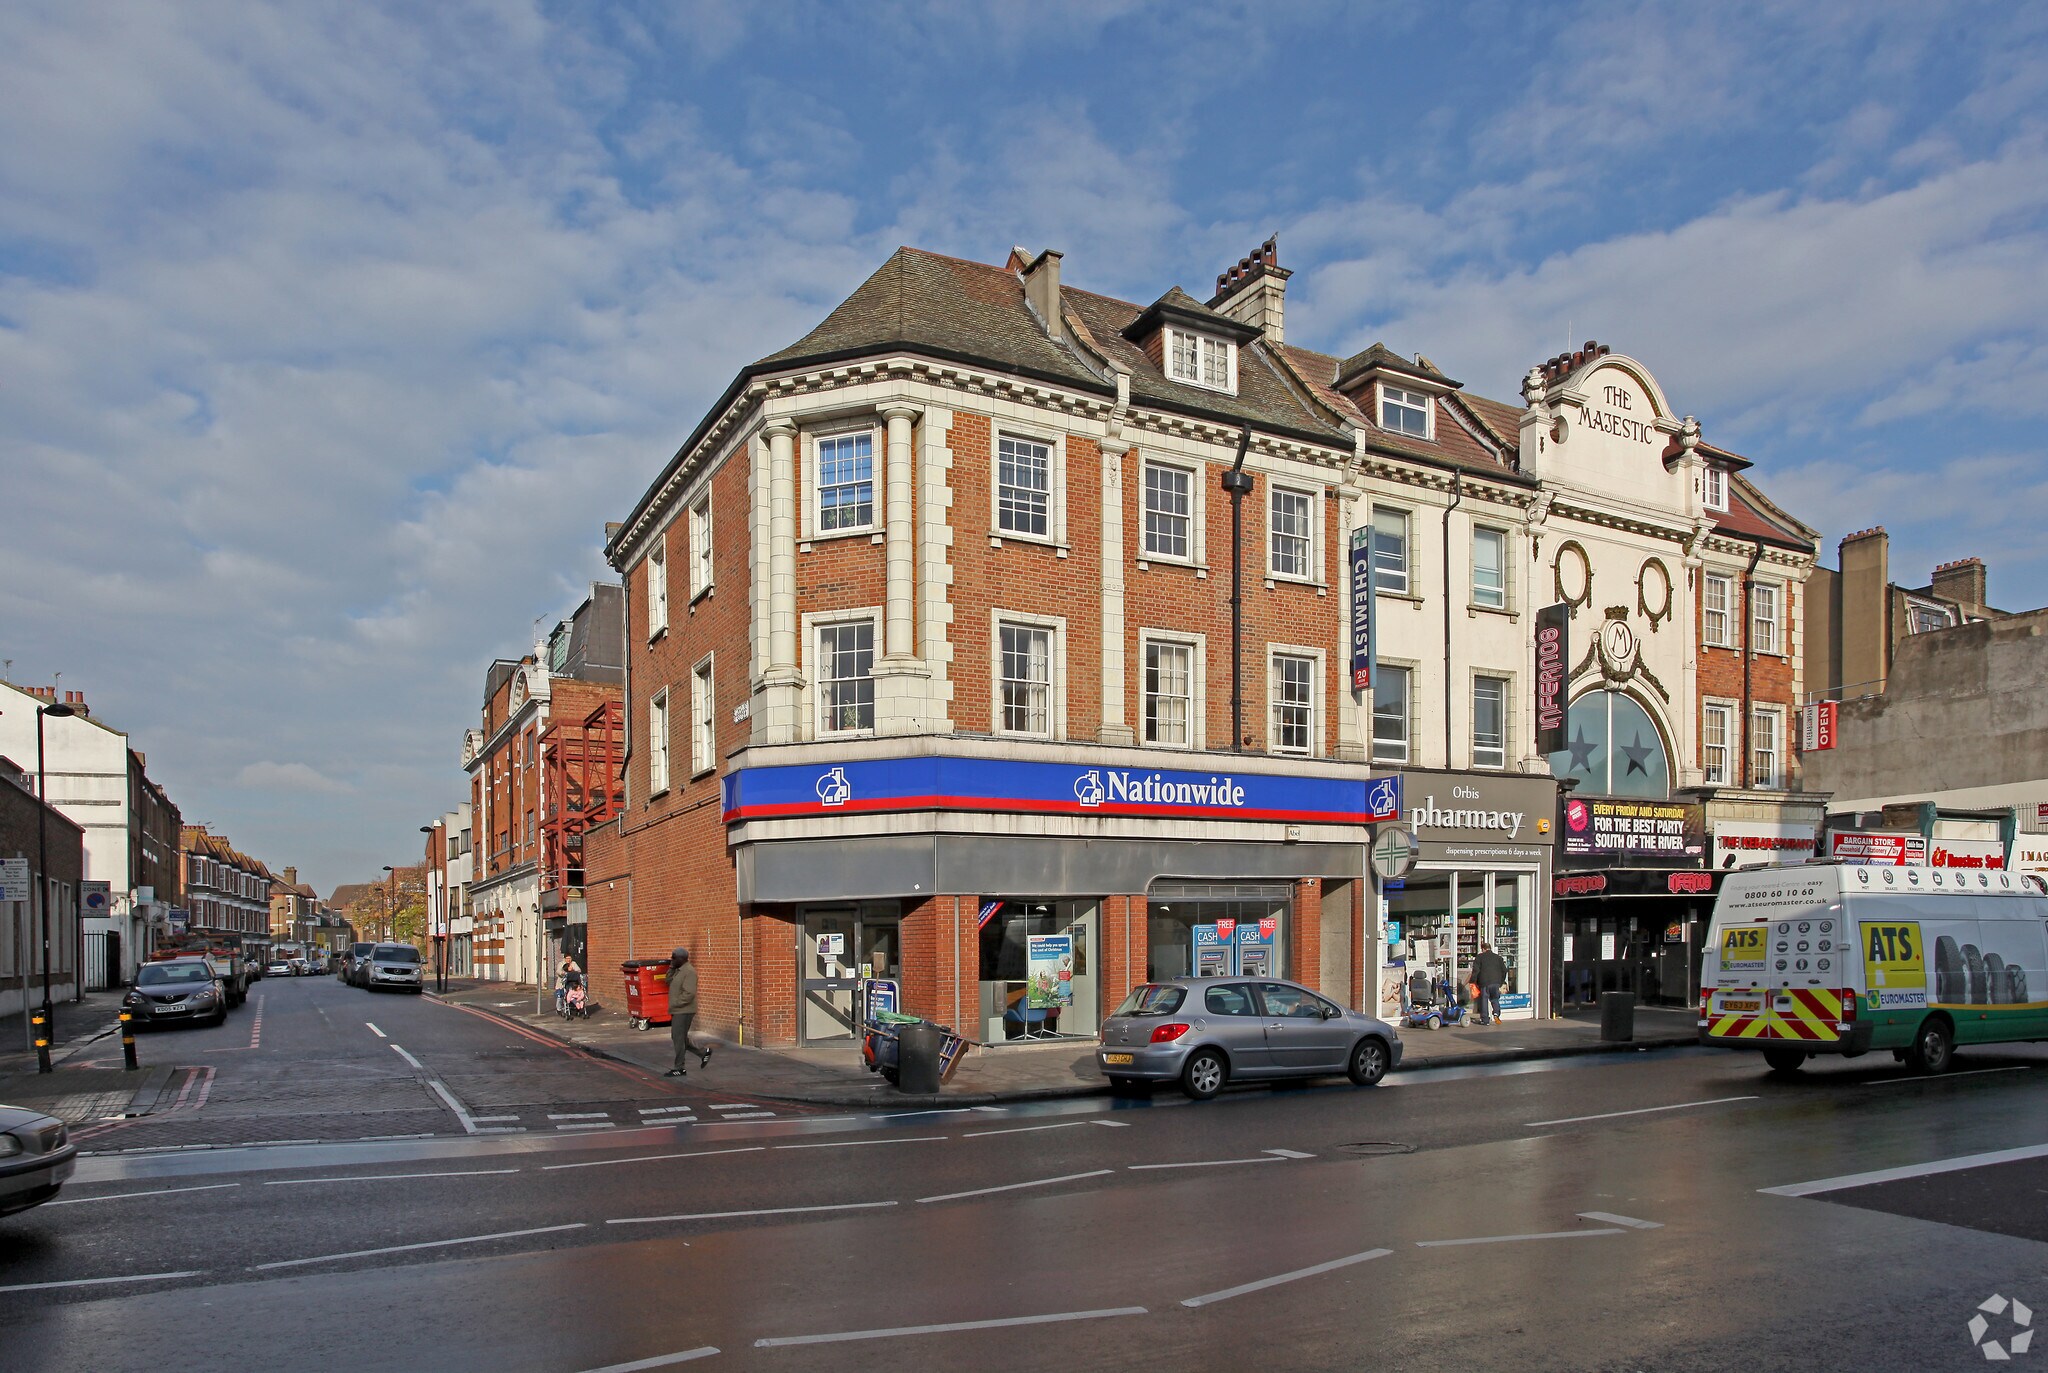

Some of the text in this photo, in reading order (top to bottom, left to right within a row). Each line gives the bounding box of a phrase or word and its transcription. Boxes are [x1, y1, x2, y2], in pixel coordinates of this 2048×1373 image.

[1604, 386, 1632, 410] THE
[1578, 406, 1652, 445] MAJESTIC
[1354, 559, 1368, 657] CHEMIST
[1357, 670, 1366, 679] 20
[1820, 708, 1828, 745] OPEN
[1107, 772, 1245, 806] Nationwide
[1453, 786, 1480, 799] Orbis
[1411, 796, 1524, 839] pharmacy
[1594, 804, 1614, 814] EVERY
[1616, 806, 1638, 816] FRIDAY
[1640, 807, 1652, 816] AND
[1654, 808, 1684, 818] SATURDAY
[1594, 818, 1613, 832] FOR
[1614, 818, 1631, 832] THE
[1633, 820, 1656, 833] BEST
[1657, 820, 1684, 834] PARTY
[1595, 834, 1684, 850] SOUTH OF THE RIVER
[1844, 836, 1873, 845] BARGAIN
[1446, 847, 1474, 856] dispensing
[1475, 848, 1507, 856] prescriptions
[1513, 848, 1524, 857] days
[1728, 898, 1828, 909] www.atseuromaster.co.uk
[1218, 920, 1233, 928] FREE
[1260, 920, 1275, 928] FREE
[1198, 932, 1218, 941] CASH
[1241, 932, 1260, 940] CASH
[1880, 993, 1925, 1004] EUROMASTER
